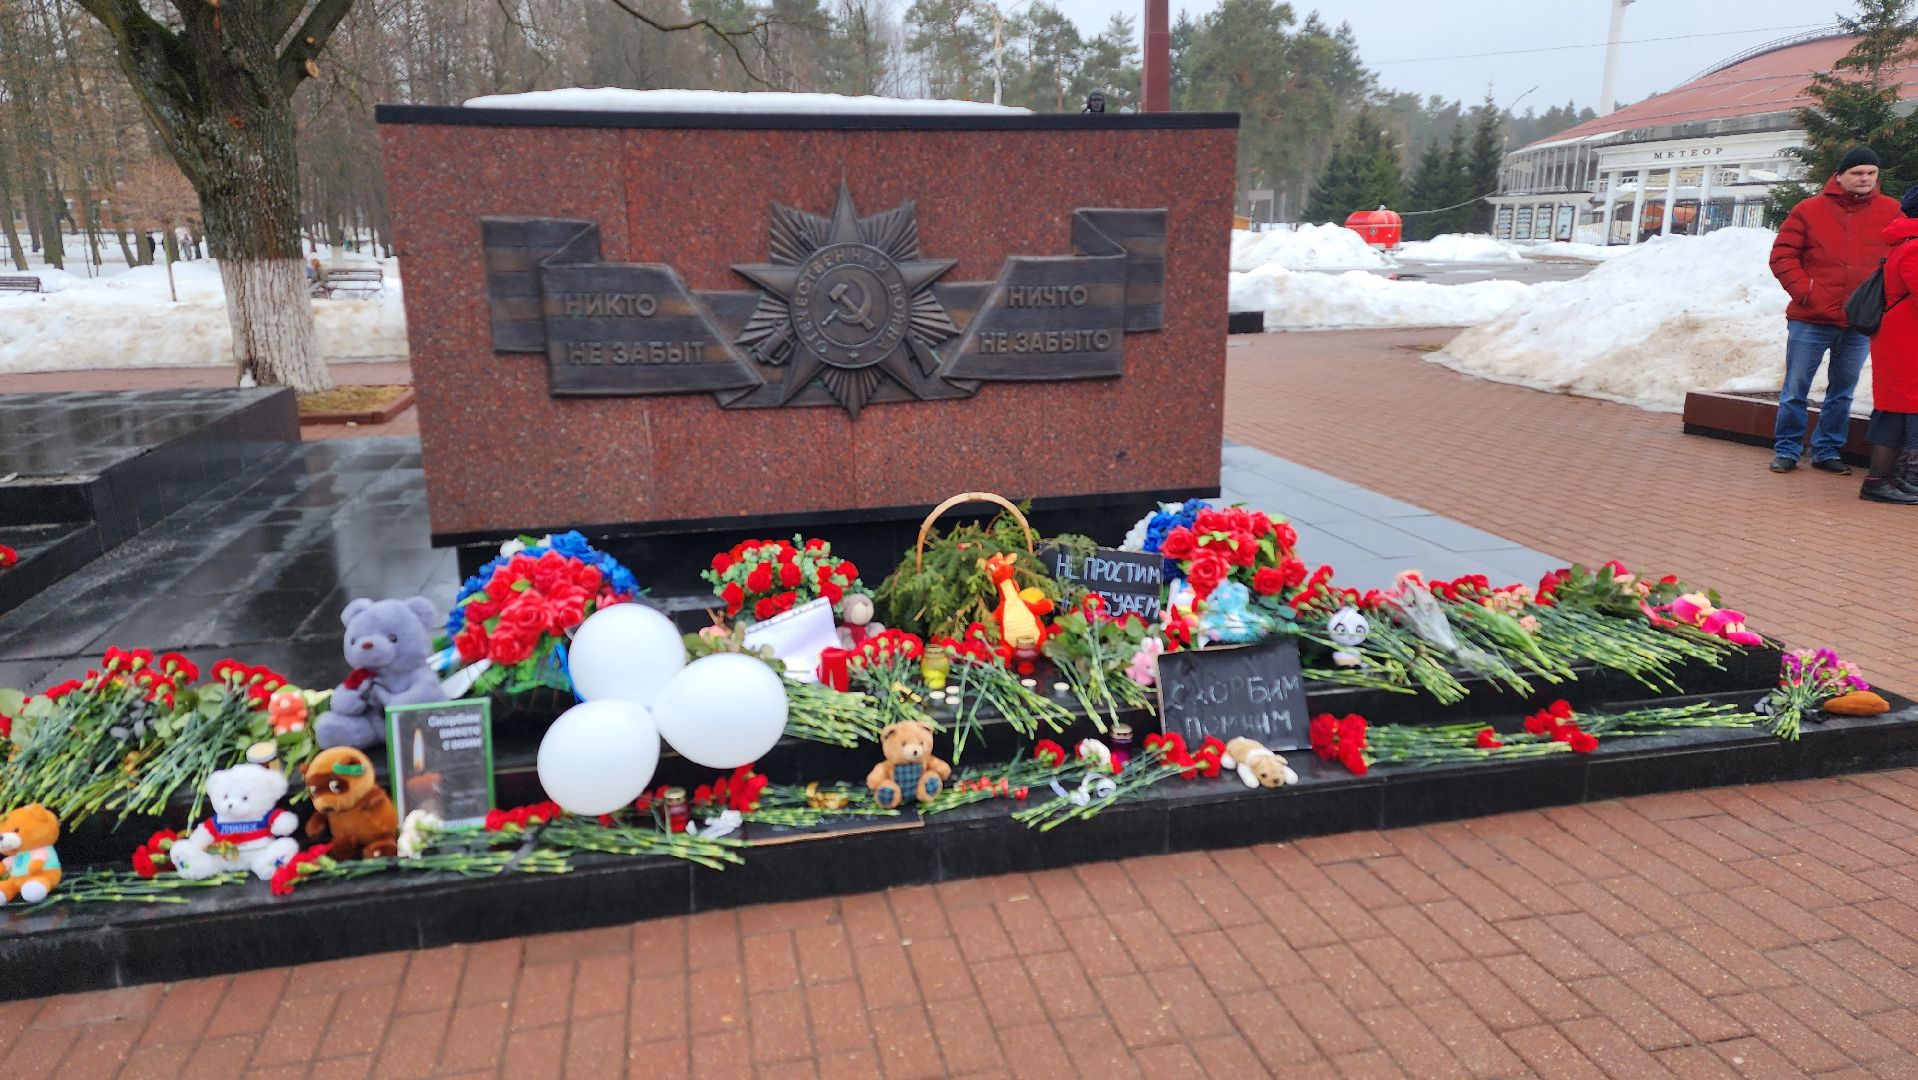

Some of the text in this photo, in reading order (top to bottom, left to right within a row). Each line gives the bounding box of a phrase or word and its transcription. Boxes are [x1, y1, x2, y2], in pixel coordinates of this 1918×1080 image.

[1653, 147, 1723, 160] МЕТЕОР
[566, 293, 657, 317] НИКТО
[1008, 284, 1088, 308] НИЧТО
[568, 341, 704, 365] НЕ ЗАБЫТ
[978, 329, 1112, 353] НЕ ЗАБЫТО
[1083, 557, 1160, 584] ПРОСТИМ
[1168, 674, 1300, 710] СКОРБИМ
